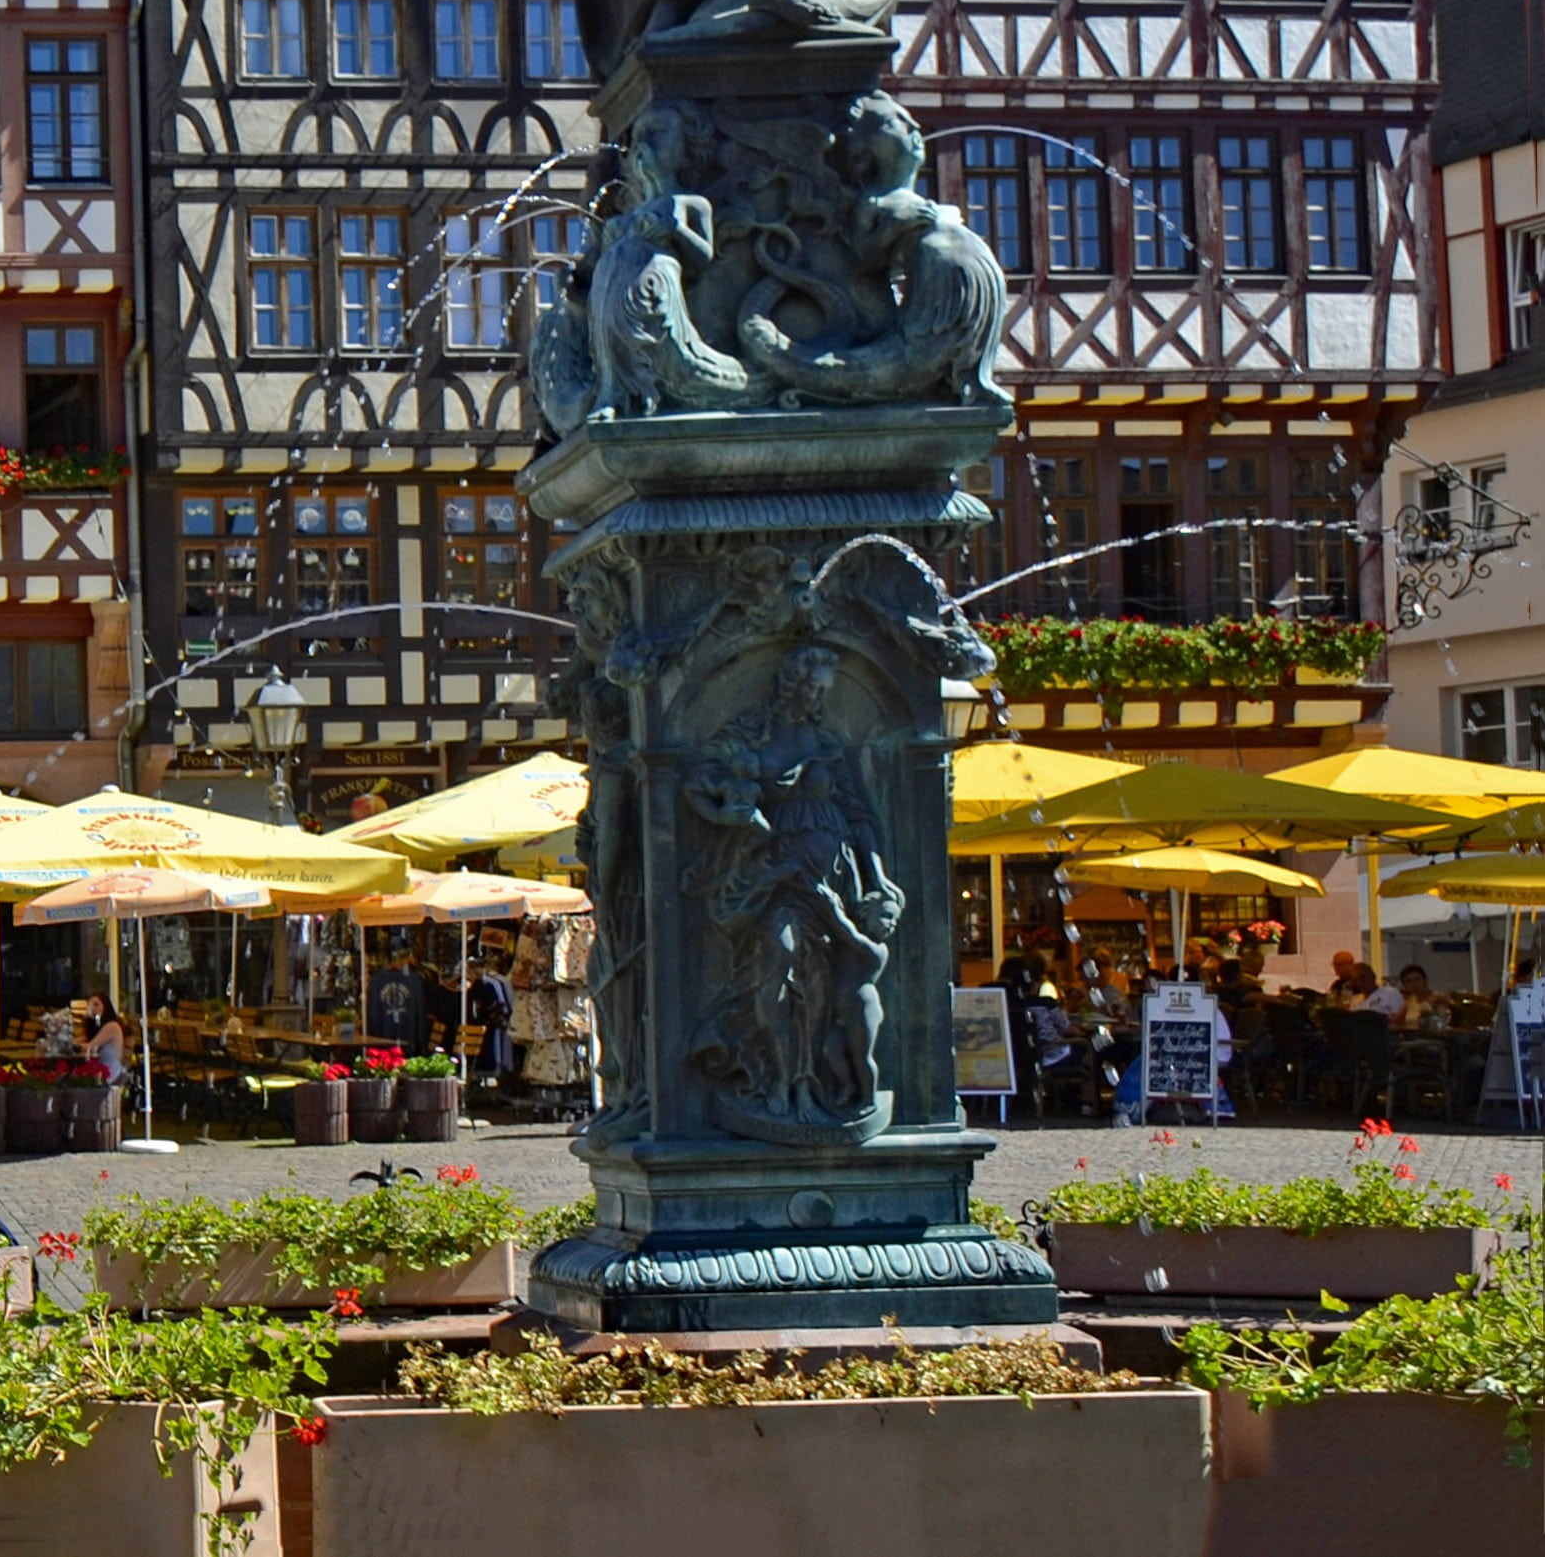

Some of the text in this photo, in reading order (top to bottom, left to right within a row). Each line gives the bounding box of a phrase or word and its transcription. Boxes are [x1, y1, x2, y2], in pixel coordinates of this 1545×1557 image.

[344, 751, 406, 765] Seit 1881
[250, 869, 296, 883] werden
[299, 869, 336, 884] kann.
